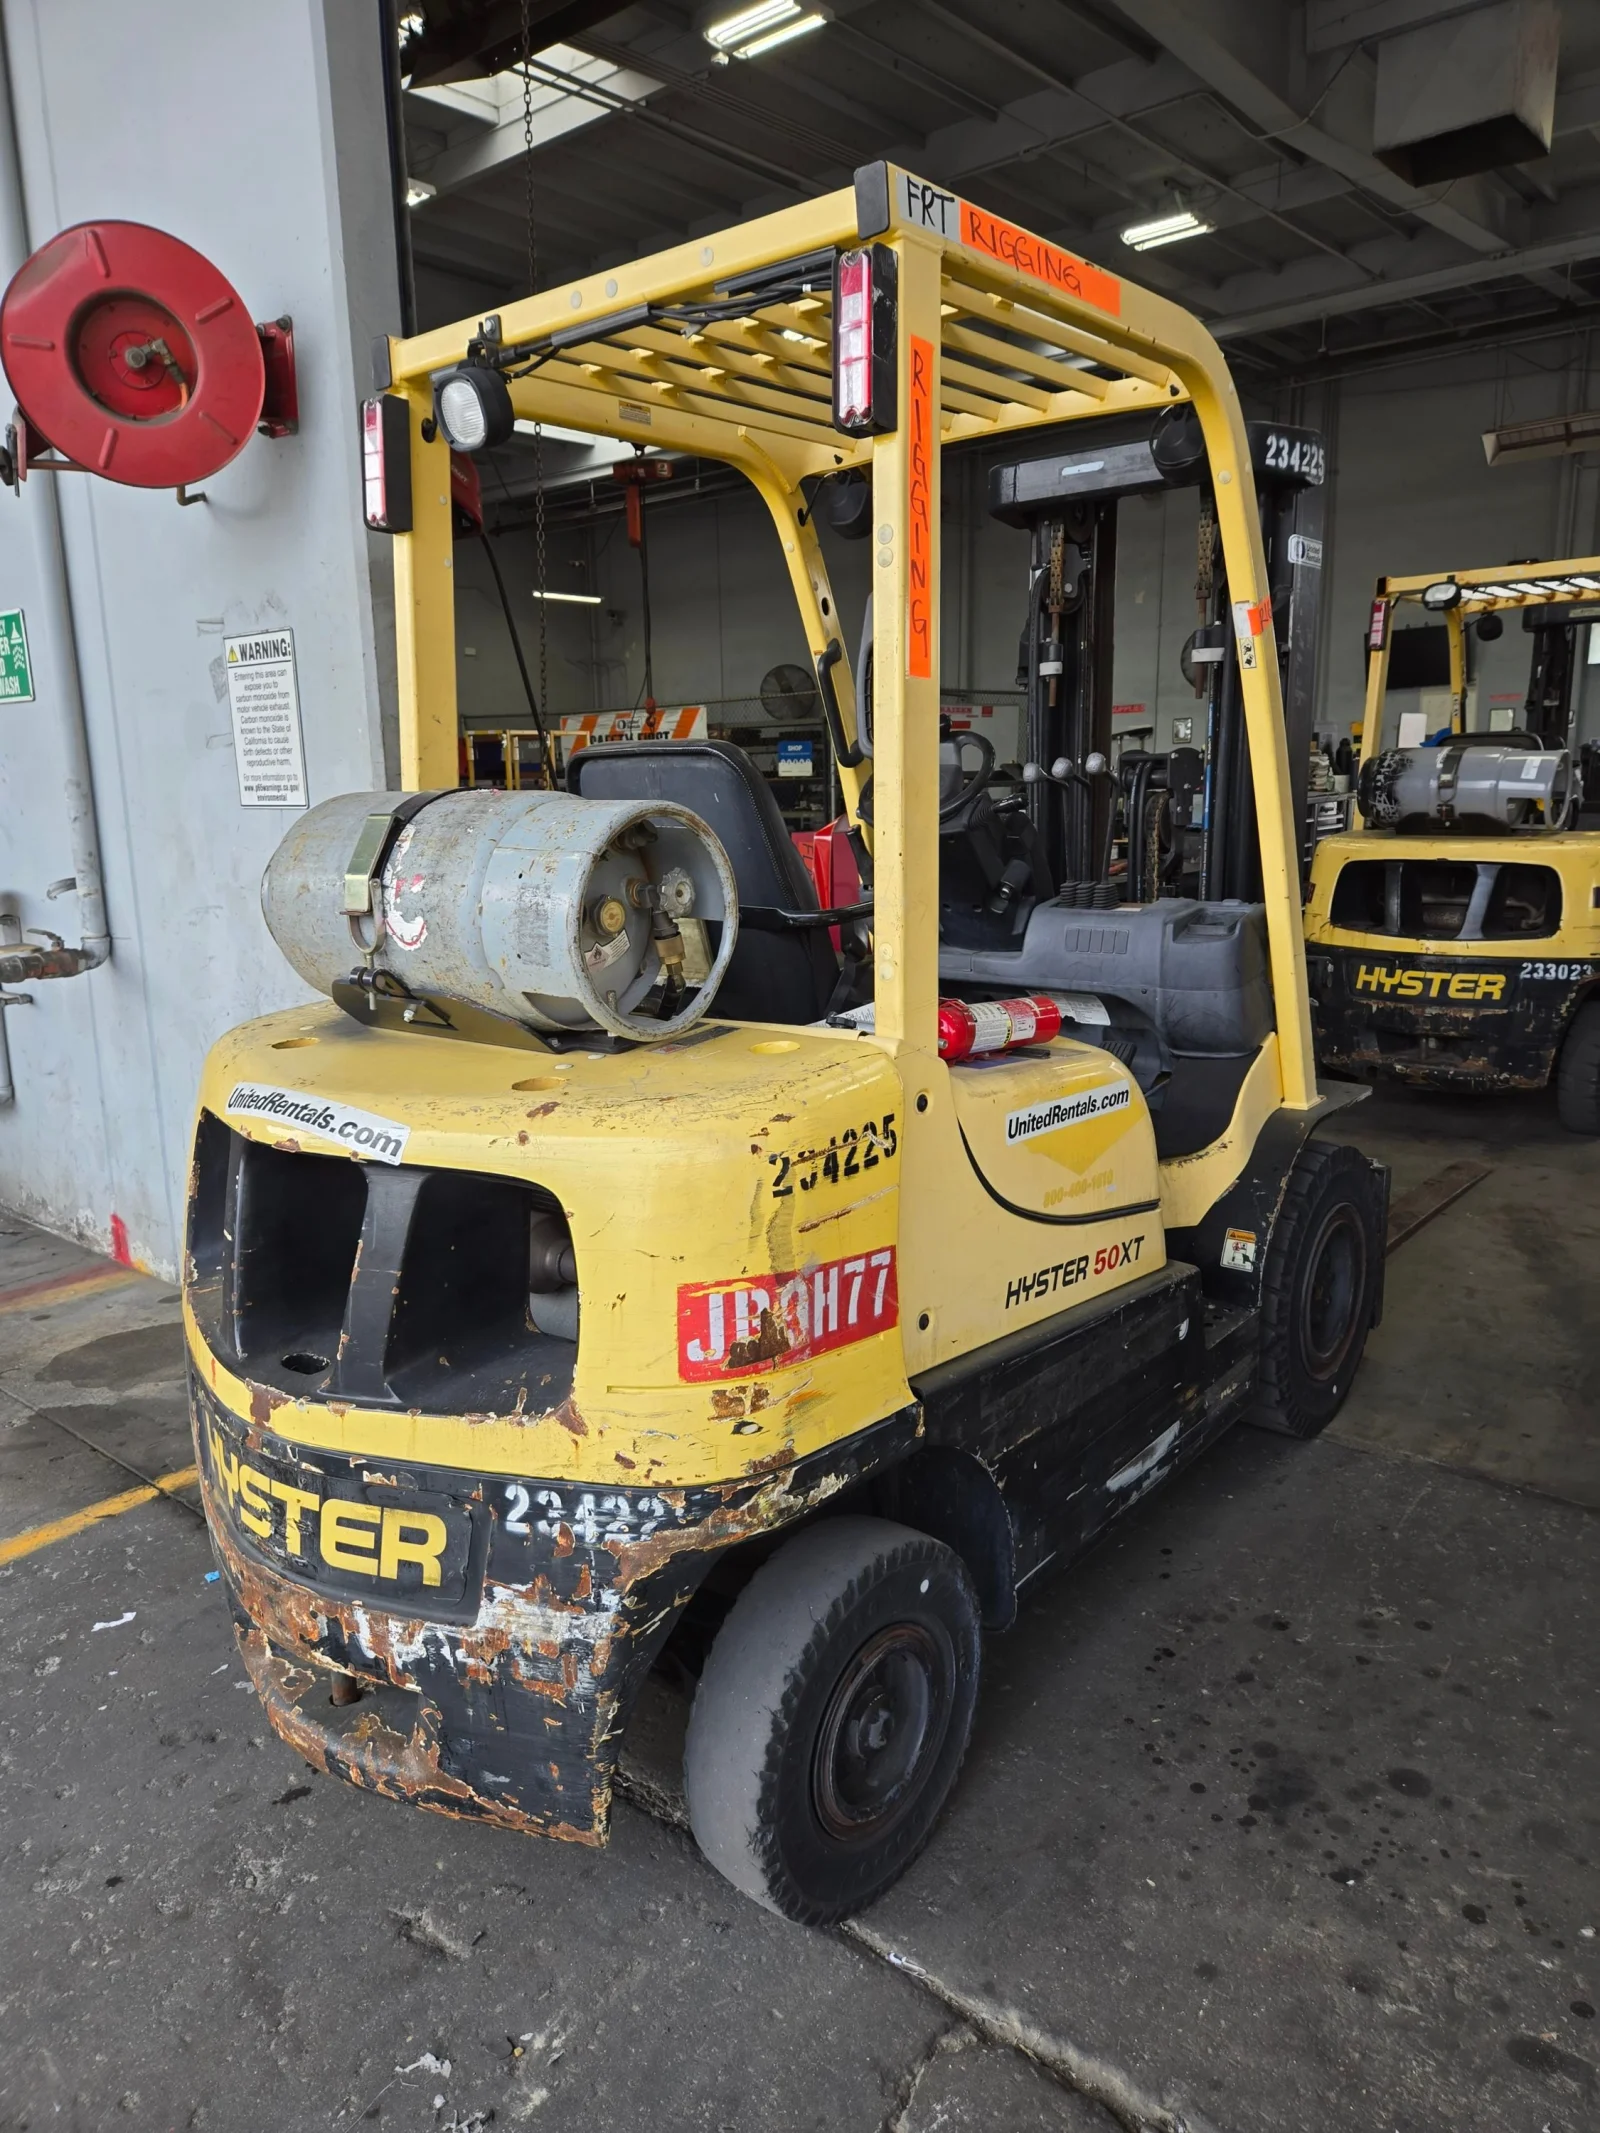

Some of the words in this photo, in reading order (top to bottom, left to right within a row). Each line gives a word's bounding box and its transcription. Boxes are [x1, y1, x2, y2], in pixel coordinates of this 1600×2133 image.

[906, 176, 955, 234] FRT
[969, 211, 1082, 296] RIGGING
[1265, 434, 1325, 477] 234225
[910, 348, 929, 659] RIGGING
[239, 638, 291, 661] WARNING:
[234, 671, 254, 681] Entering
[255, 671, 264, 679] this
[265, 669, 276, 678] area
[277, 669, 287, 677] can
[244, 683, 262, 692] expose
[263, 682, 272, 691] you
[236, 693, 252, 703] carbon
[253, 692, 277, 701] monoxide
[278, 691, 290, 699] from
[237, 705, 250, 713] motor
[251, 704, 268, 712] vehicle
[240, 715, 258, 724] Carbon
[259, 714, 283, 722] monoxide
[240, 727, 256, 735] known
[257, 726, 261, 734] to
[272, 724, 285, 733] State
[286, 724, 291, 732] of
[244, 737, 267, 745] California
[268, 736, 273, 744] to
[274, 736, 289, 744] cause
[243, 748, 254, 756] birth
[254, 747, 272, 756] defects
[247, 759, 276, 768] reproductive
[262, 773, 286, 781] information
[287, 774, 292, 782] go
[1355, 964, 1506, 1000] HYSTER
[1008, 1089, 1129, 1139] UnitedRentals.com
[228, 1087, 402, 1157] UnitedRentals.com
[1005, 1254, 1090, 1310] HYSTER
[1093, 1235, 1145, 1276] 50XT
[207, 1423, 447, 1587] HYSTER
